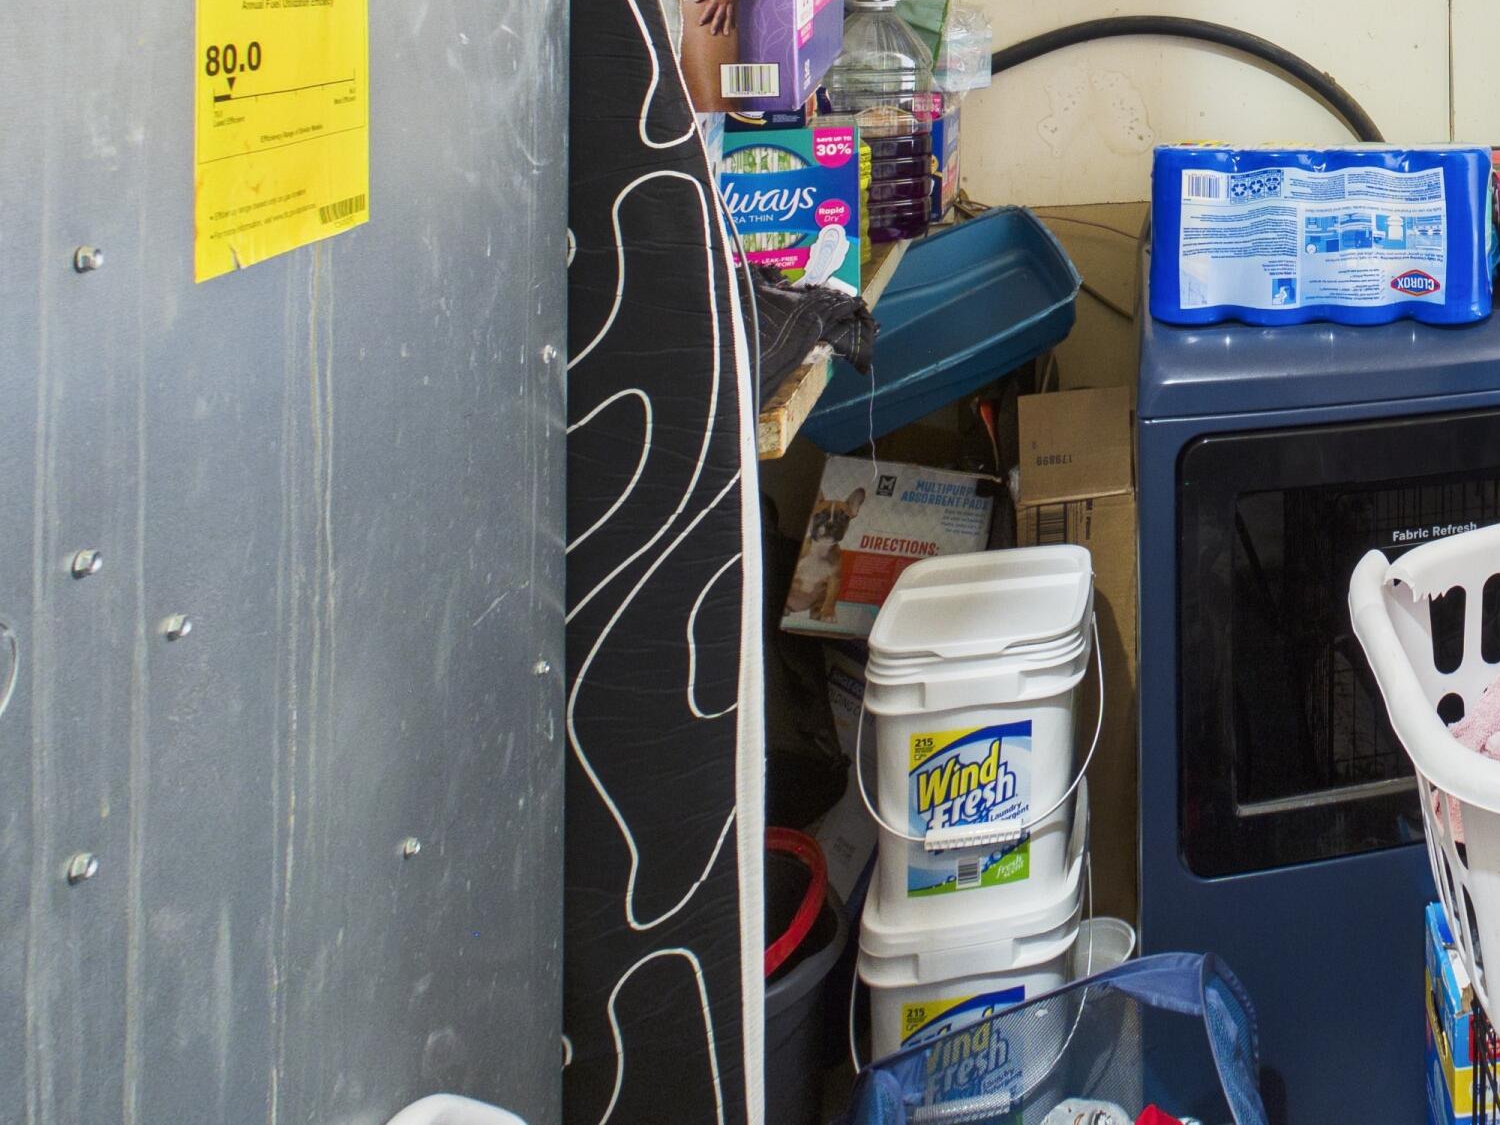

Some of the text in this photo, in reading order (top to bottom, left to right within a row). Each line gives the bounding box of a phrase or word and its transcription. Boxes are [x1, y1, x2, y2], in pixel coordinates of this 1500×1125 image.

[205, 41, 262, 77] 80.0
[816, 143, 852, 156] 30%
[722, 182, 817, 221] lways
[749, 214, 774, 222] THIN
[818, 206, 845, 216] Rapid
[823, 215, 839, 223] Dry
[1396, 277, 1435, 291] CLOROX
[916, 479, 977, 498] MULTIPURP
[901, 490, 961, 508] ABSORBENT
[1392, 521, 1477, 542] Fabric Refresh
[859, 534, 940, 557] DIRECTIONS:
[914, 738, 934, 747] 215
[918, 739, 1001, 812] Wind
[928, 764, 1015, 830] Fresh
[990, 801, 1022, 822] Laundry
[906, 1007, 925, 1018] 215
